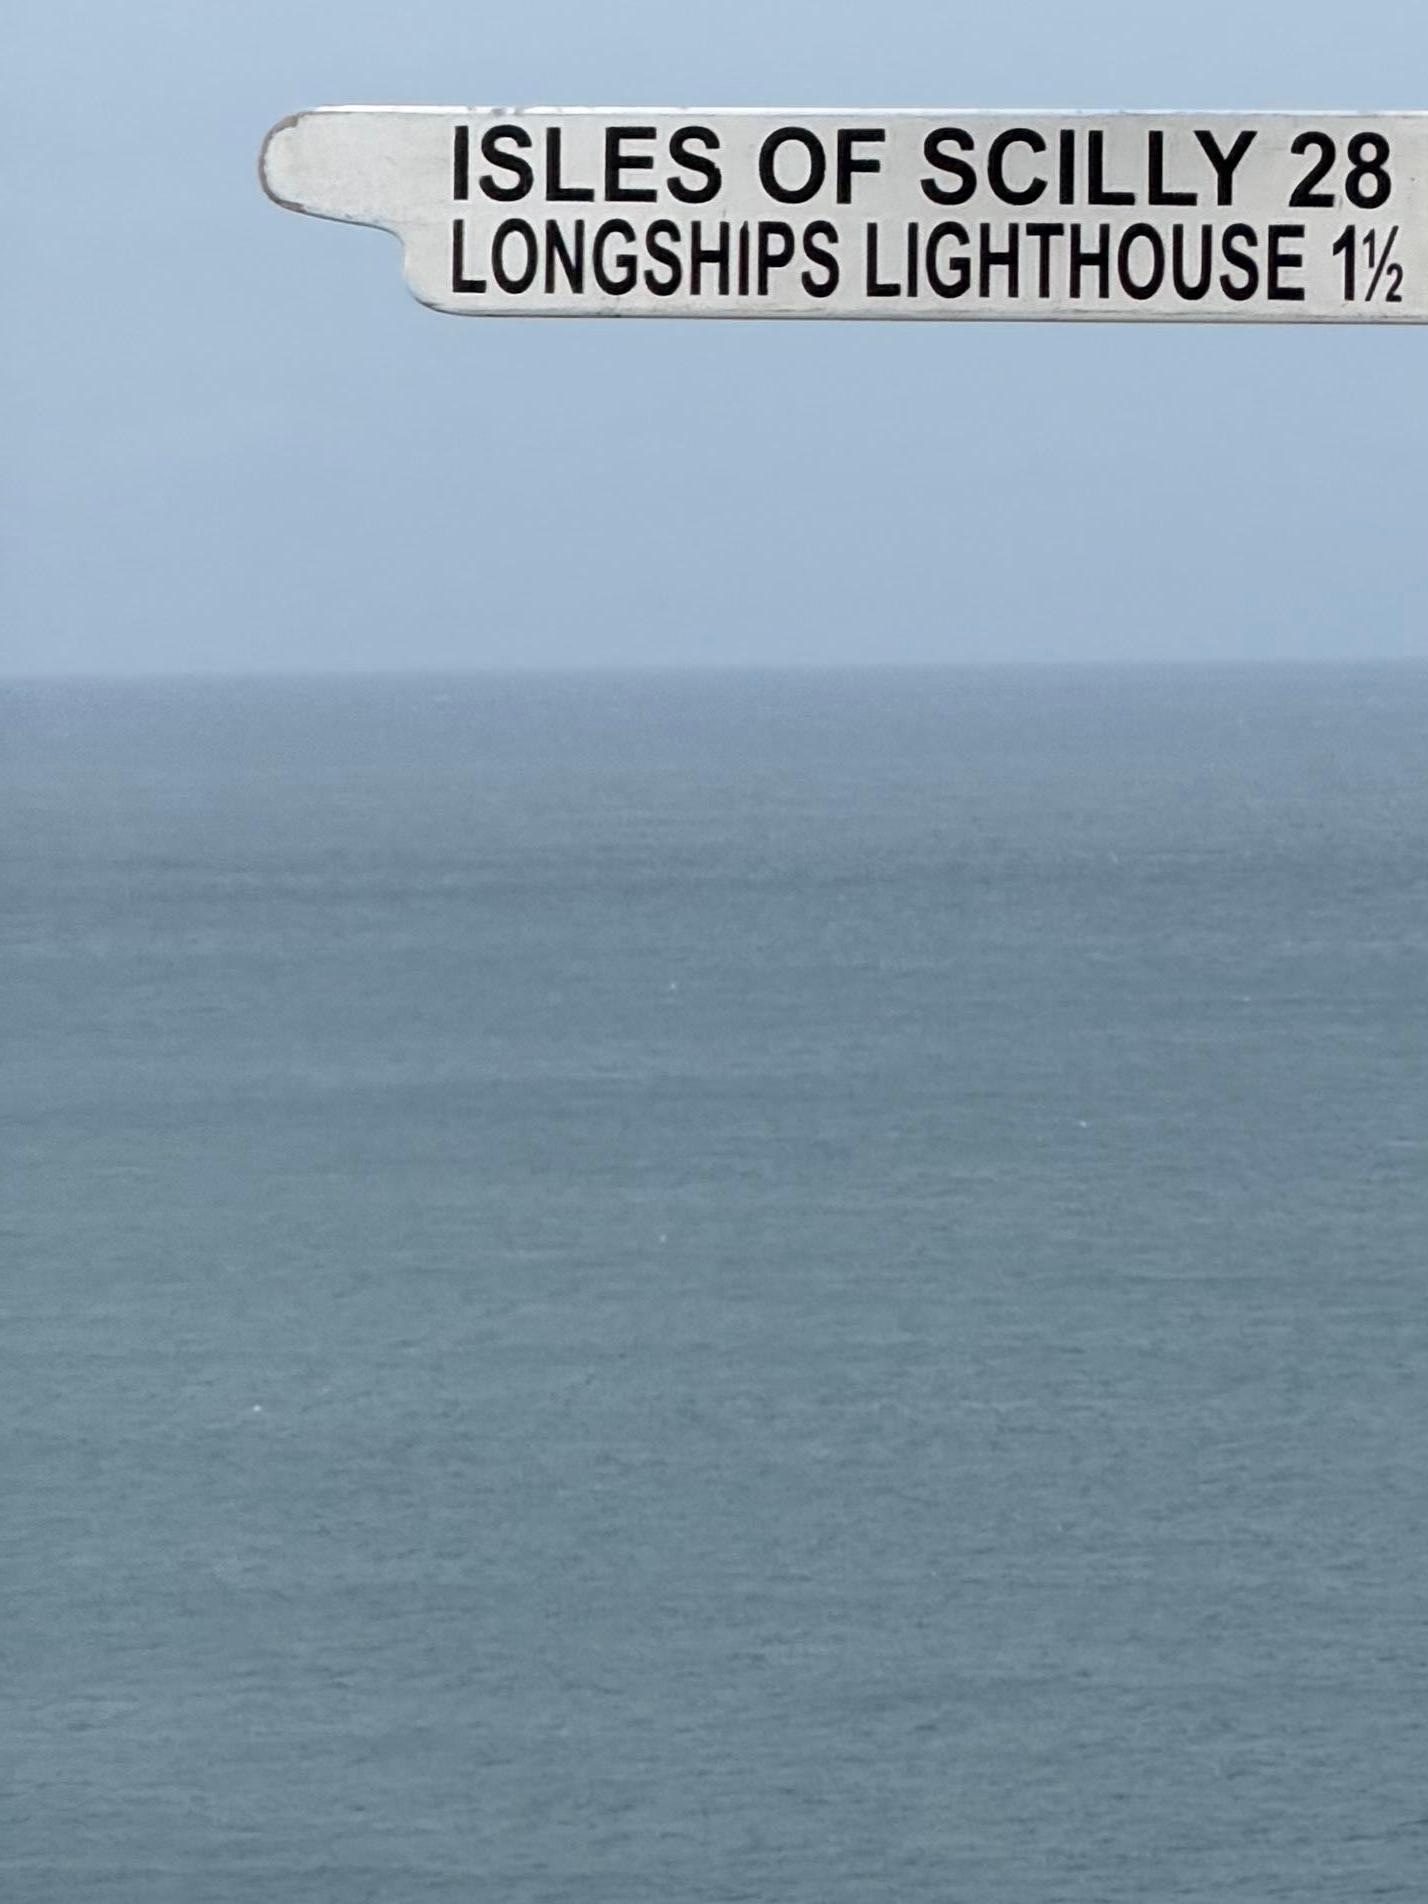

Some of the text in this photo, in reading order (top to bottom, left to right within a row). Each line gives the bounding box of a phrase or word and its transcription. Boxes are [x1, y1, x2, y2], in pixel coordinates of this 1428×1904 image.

[453, 124, 1392, 210] ISLES OF SCILLY 28
[452, 218, 840, 298] LONGSHIPS
[866, 221, 1305, 301] LIGHTHOUSE
